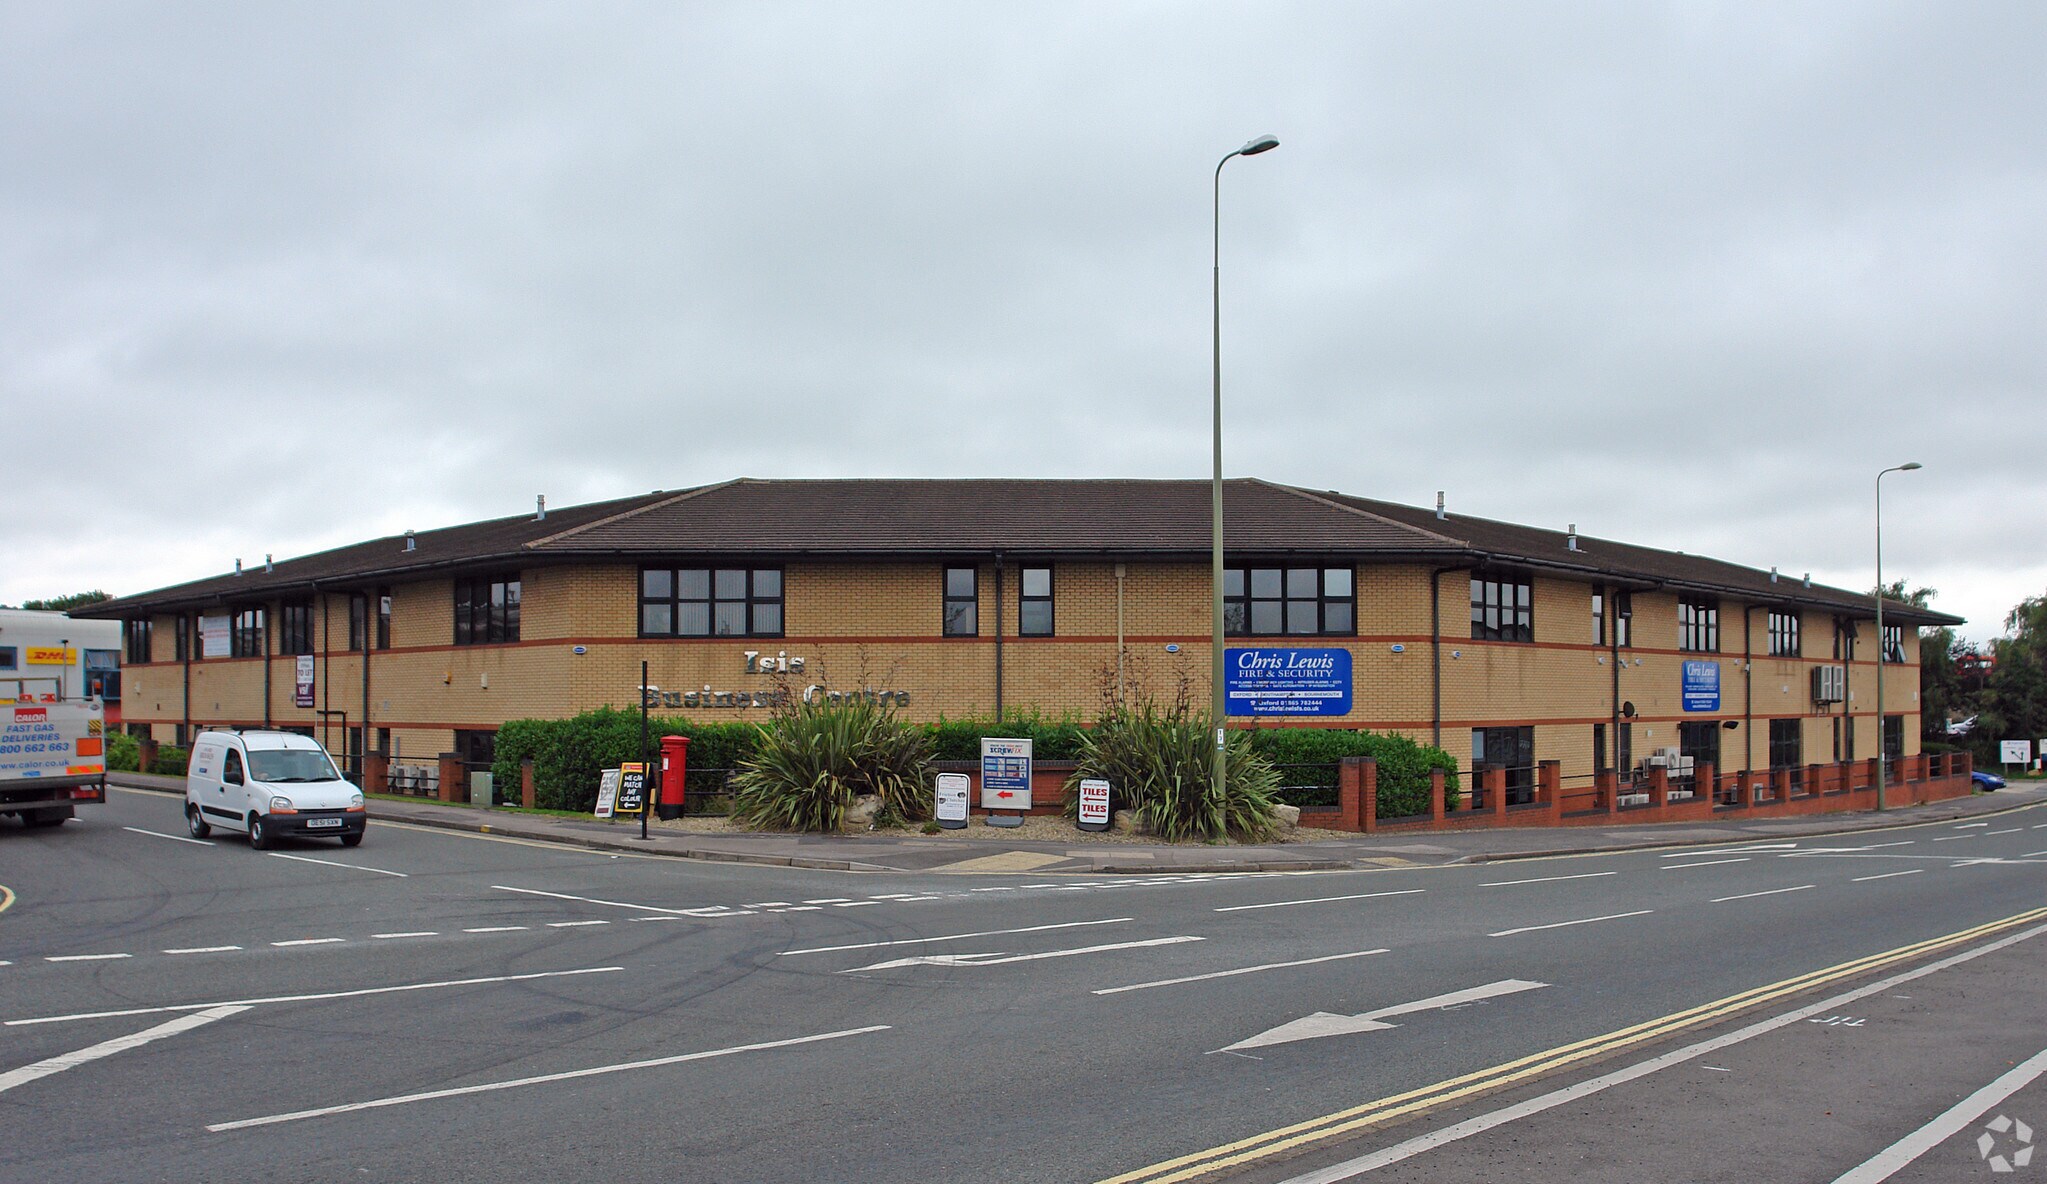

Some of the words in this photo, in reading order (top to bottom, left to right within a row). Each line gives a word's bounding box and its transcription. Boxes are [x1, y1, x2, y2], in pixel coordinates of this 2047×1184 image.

[744, 651, 805, 674] Isis
[1238, 651, 1283, 669] Chris
[1286, 652, 1334, 669] Lewis
[1238, 670, 1264, 678] FIRE
[1266, 670, 1275, 678] &
[1278, 670, 1334, 678] SECURITY
[15, 714, 46, 722] CALOR
[6, 724, 31, 732] FAST
[34, 724, 55, 732] GAS
[2, 733, 60, 743] DELIVERIES
[24, 743, 45, 753] 662
[49, 742, 70, 752] 663
[1082, 788, 1107, 797] TILES
[1082, 804, 1107, 813] TILES
